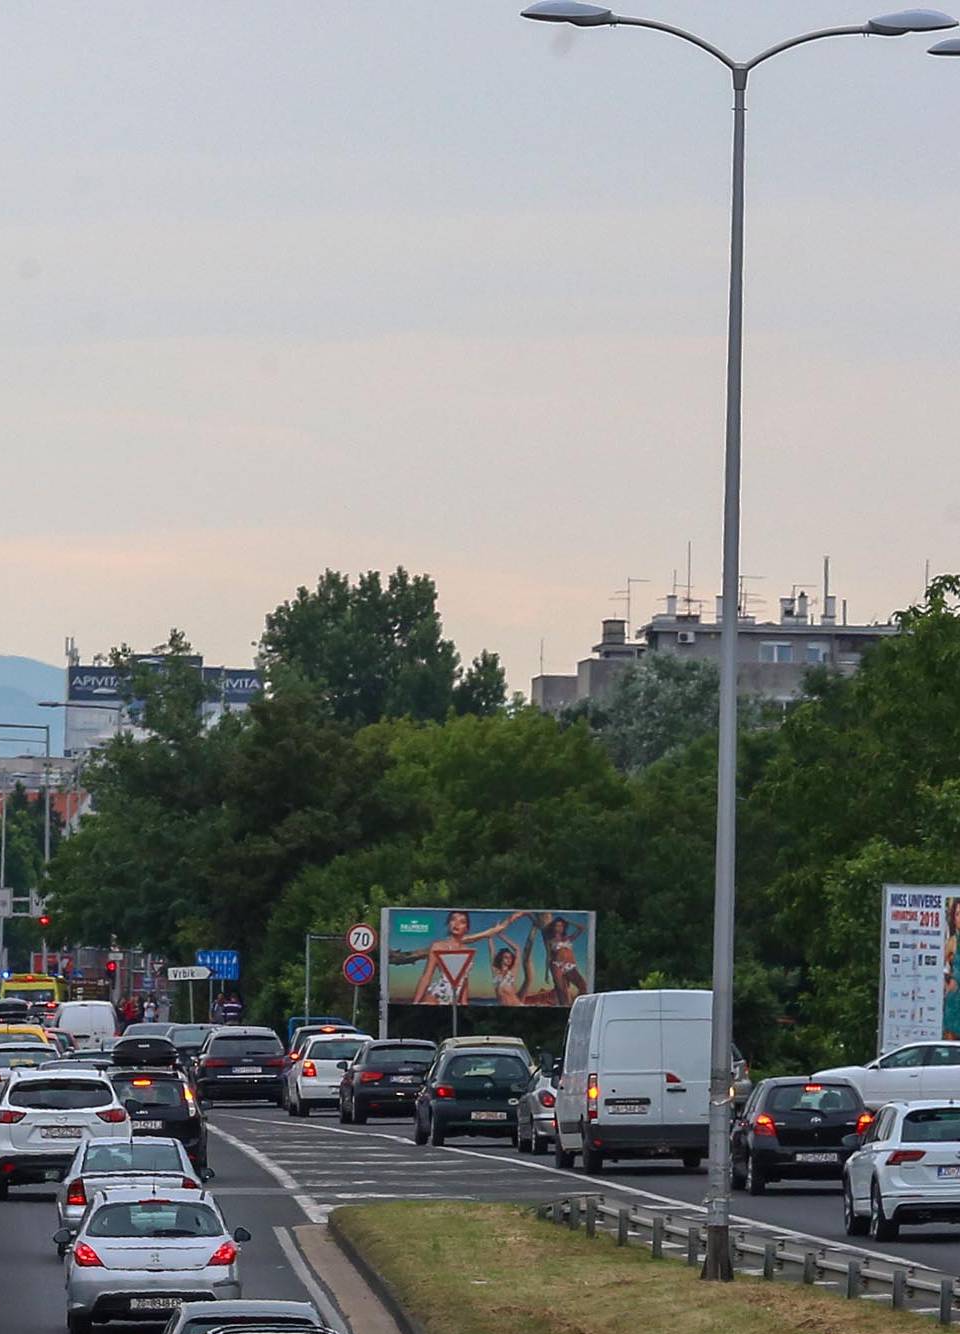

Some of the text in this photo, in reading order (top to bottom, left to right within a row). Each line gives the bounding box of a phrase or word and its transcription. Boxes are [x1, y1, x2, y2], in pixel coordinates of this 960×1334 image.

[891, 893, 942, 908] MISS UNIVERSE
[920, 911, 940, 928] 2018
[353, 932, 370, 947] 70
